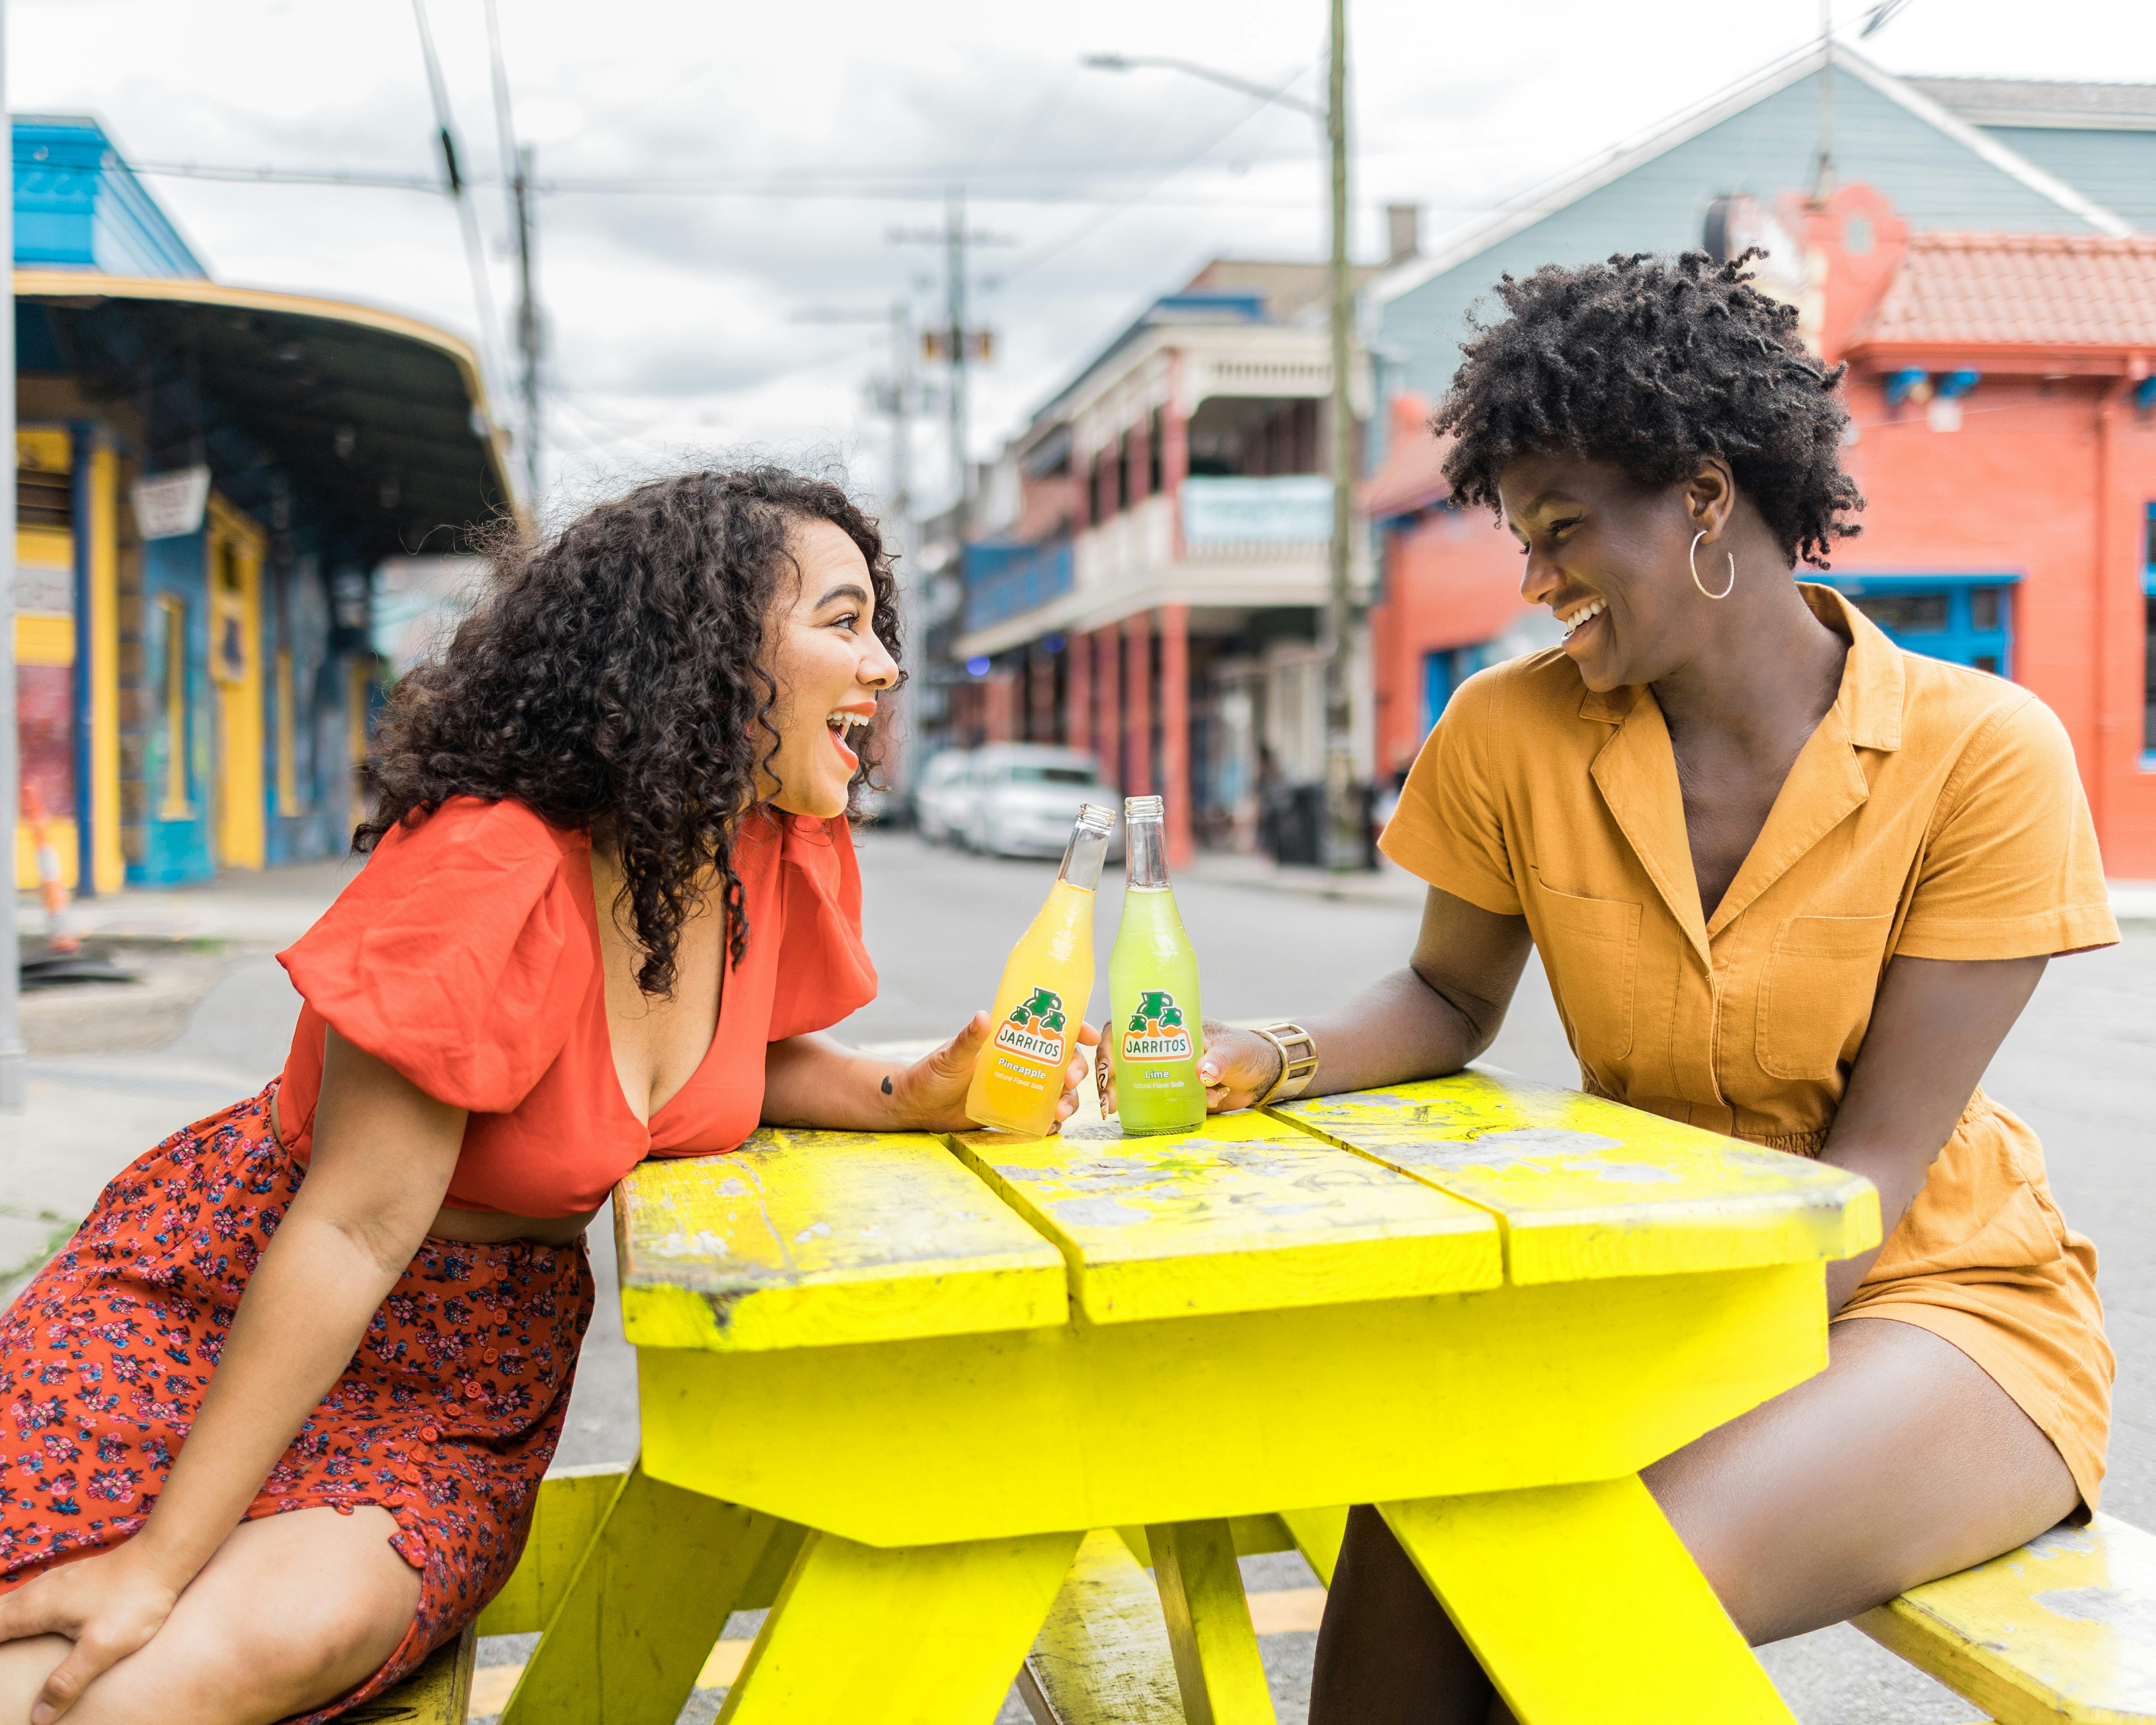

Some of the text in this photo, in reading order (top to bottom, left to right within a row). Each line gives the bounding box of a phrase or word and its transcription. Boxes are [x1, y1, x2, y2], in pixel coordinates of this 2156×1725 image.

[1000, 1029, 1059, 1057] JARRITOS
[1126, 1039, 1186, 1053] JARRITOS
[998, 1057, 1046, 1079] Pineapple
[1145, 1070, 1170, 1079] Lime
[994, 1071, 1044, 1091] Natural Flavor Soda
